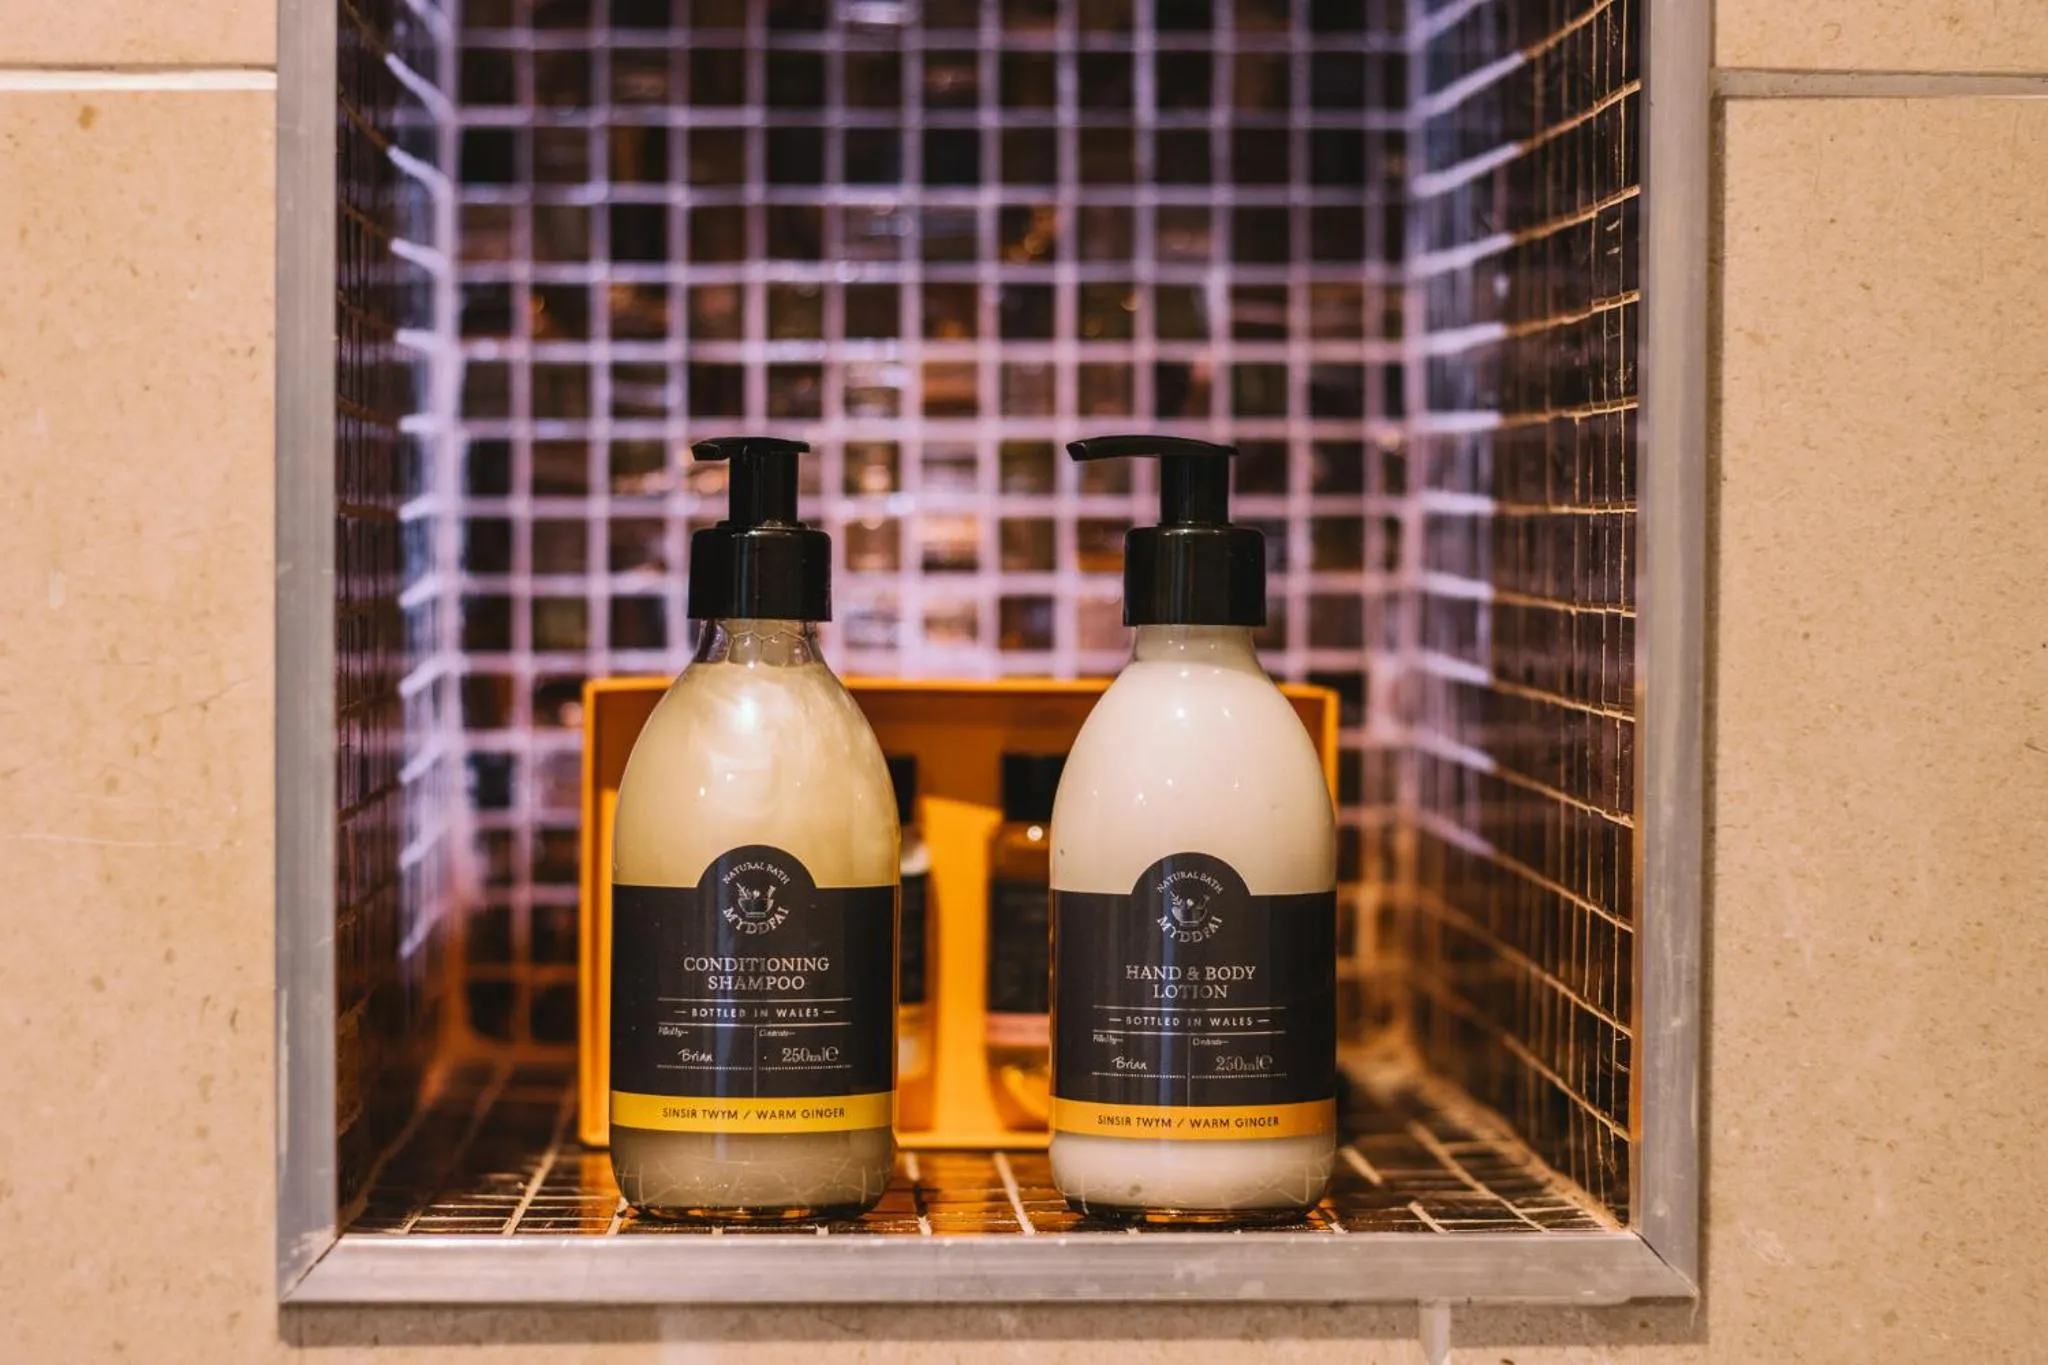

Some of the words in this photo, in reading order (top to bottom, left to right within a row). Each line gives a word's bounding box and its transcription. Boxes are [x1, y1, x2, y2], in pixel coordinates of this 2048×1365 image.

[723, 862, 764, 884] NATURAL
[766, 864, 790, 884] BATH
[1157, 871, 1199, 893] NATURAL
[1200, 873, 1223, 894] BATH
[723, 906, 789, 934] MYDDFAI
[1157, 915, 1222, 942] MYDDFAI
[683, 957, 830, 972] CONDITIONING
[1126, 965, 1182, 980] HAND
[1187, 966, 1199, 981] &
[1205, 966, 1256, 981] BODY
[707, 976, 805, 991] SHAMPOO
[1154, 984, 1228, 999] LOTION
[691, 1008, 746, 1018] BOTTLED
[754, 1009, 769, 1018] IN
[776, 1008, 819, 1018] WALES
[1126, 1016, 1180, 1026] BOTTLED
[1188, 1017, 1202, 1026] IN
[1209, 1017, 1253, 1026] WALES
[677, 1048, 713, 1063] Brian
[1111, 1056, 1147, 1070] Brian
[662, 1107, 697, 1119] SINSIR
[702, 1109, 738, 1120] TWYM
[757, 1108, 797, 1119] WARM
[801, 1107, 845, 1119] GINGER
[1098, 1114, 1131, 1126] SINSIR
[1136, 1117, 1172, 1128] TWYM
[1190, 1117, 1230, 1128] WARM
[1235, 1116, 1279, 1127] GINGER
